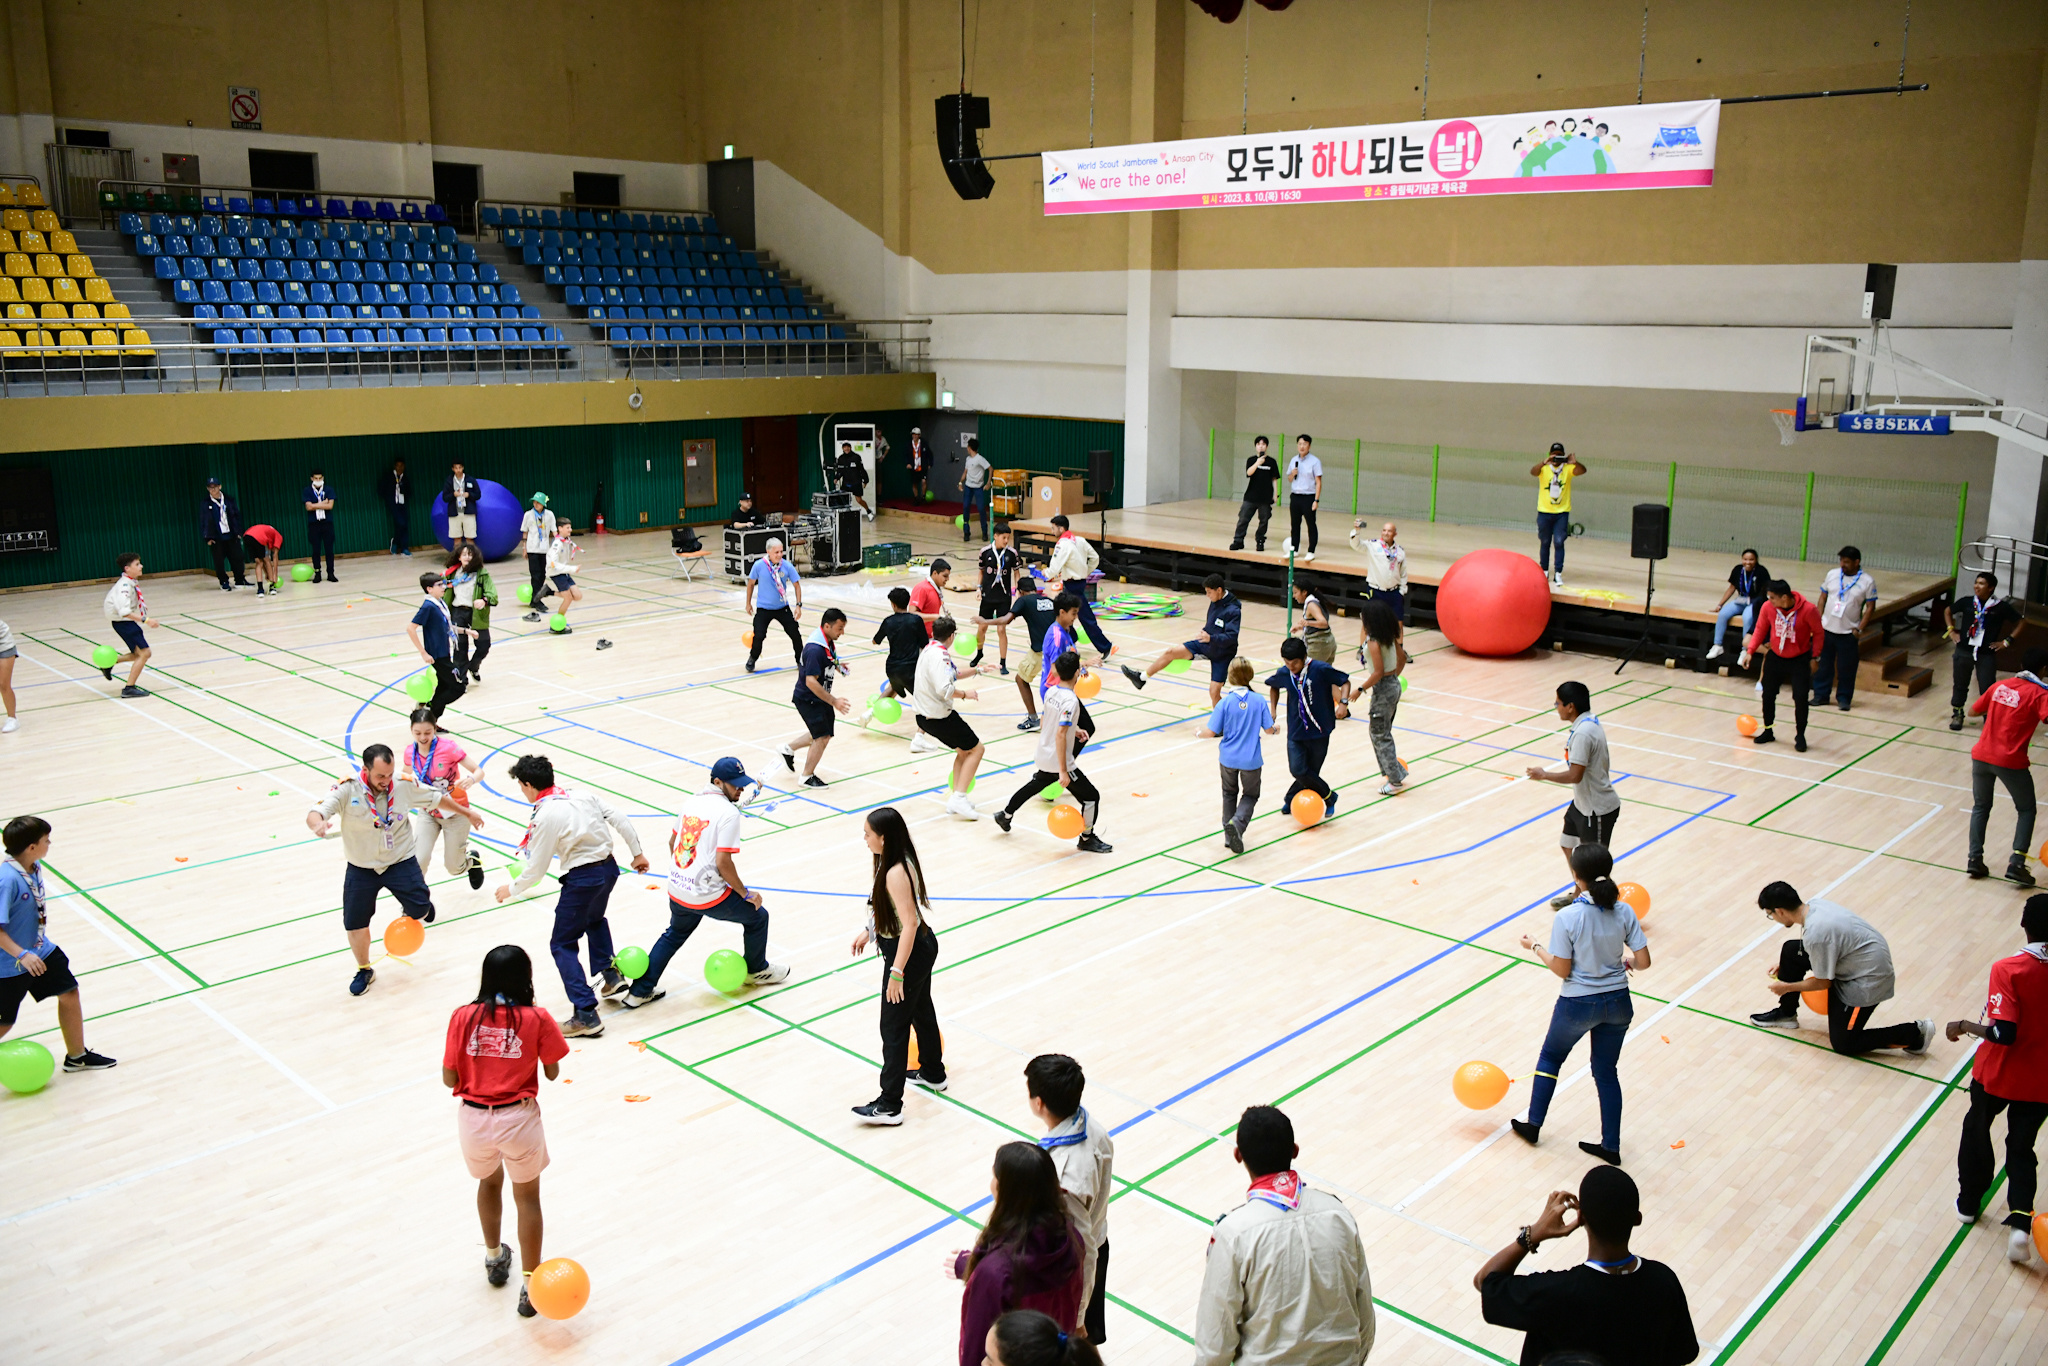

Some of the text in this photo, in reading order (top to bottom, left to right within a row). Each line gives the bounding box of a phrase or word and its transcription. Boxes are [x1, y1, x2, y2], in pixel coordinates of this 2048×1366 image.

[1077, 152, 1214, 170] World Scout Jamboree Ansan City
[1227, 143, 1303, 182] 모두가
[1437, 131, 1477, 172] 날!
[1078, 167, 1186, 190] We are the one!
[1280, 190, 1301, 200] 16:30
[1441, 181, 1468, 194] 체육관
[28, 532, 33, 540] 6
